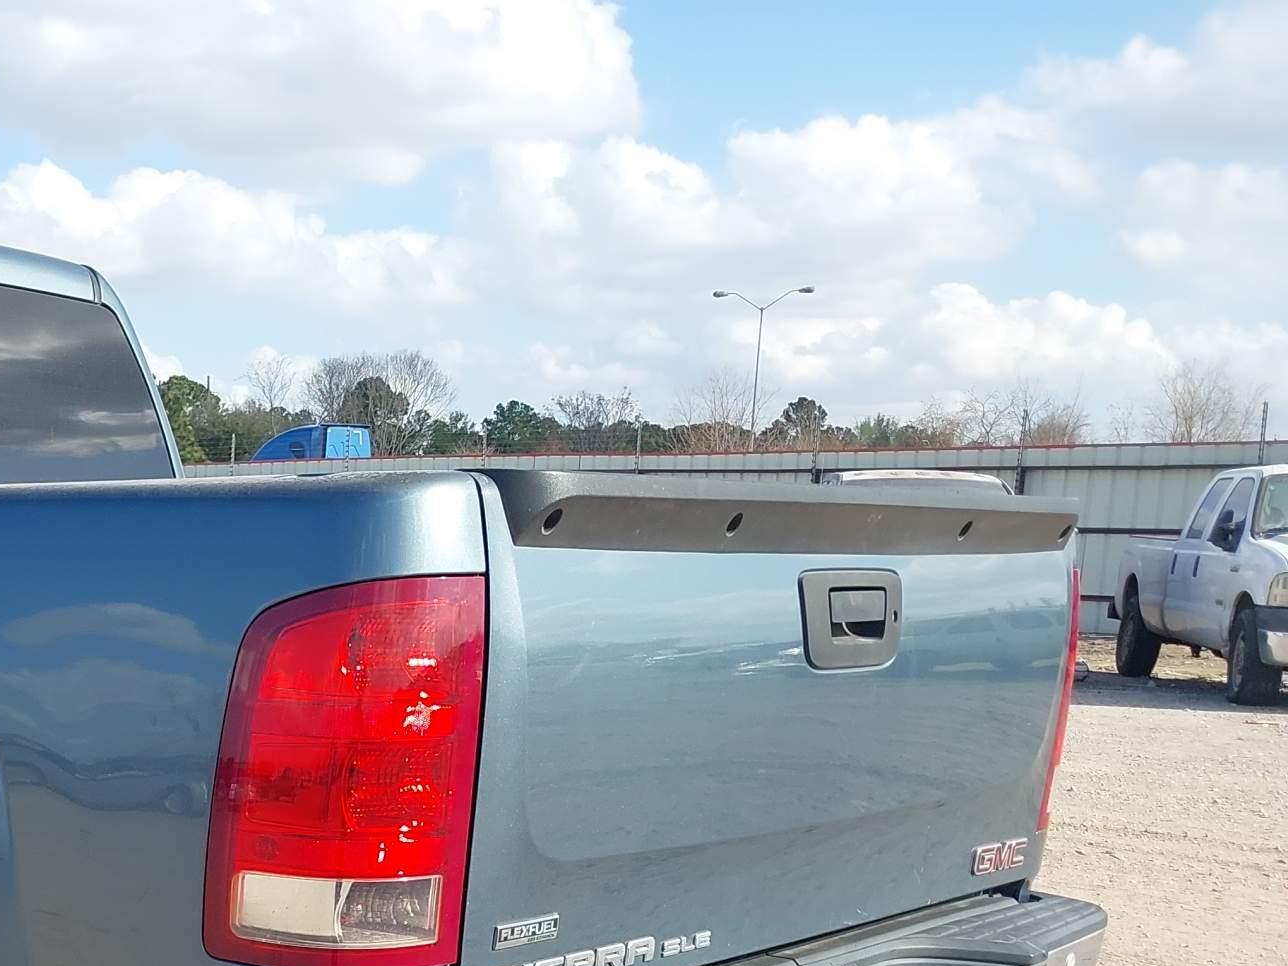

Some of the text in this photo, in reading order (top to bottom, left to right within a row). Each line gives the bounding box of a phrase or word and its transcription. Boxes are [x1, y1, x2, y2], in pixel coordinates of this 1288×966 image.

[971, 838, 1028, 875] GMC
[500, 920, 557, 941] FLEXFUEL
[661, 930, 712, 958] SLE
